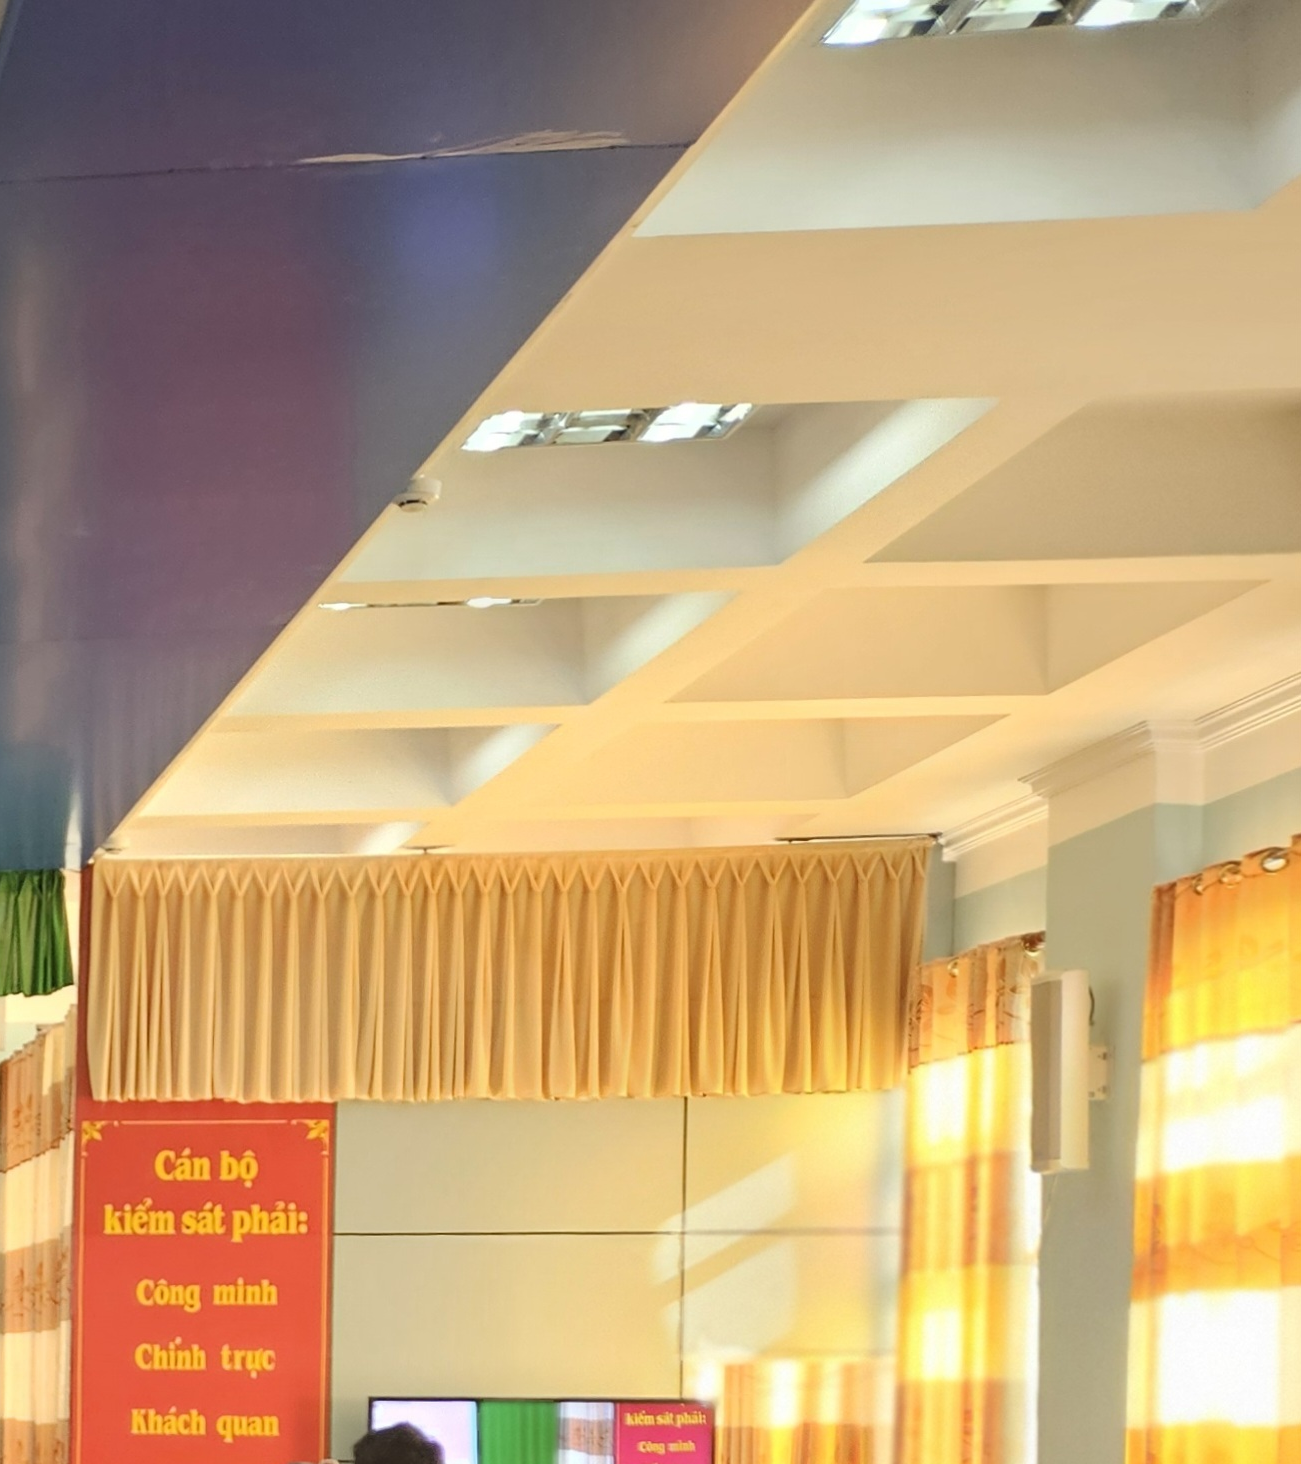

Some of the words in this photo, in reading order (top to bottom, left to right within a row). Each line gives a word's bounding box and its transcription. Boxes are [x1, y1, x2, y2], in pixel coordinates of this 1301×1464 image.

[154, 1147, 211, 1181] Cán
[219, 1149, 259, 1188] bộ
[103, 1197, 176, 1235] kiểm
[181, 1201, 226, 1235] sát
[230, 1200, 308, 1243] phải:
[135, 1278, 201, 1313] Công
[212, 1277, 278, 1306] minh
[134, 1336, 207, 1370] Chính
[220, 1343, 276, 1379] trực
[130, 1406, 207, 1435] Khách
[215, 1414, 280, 1443] quan
